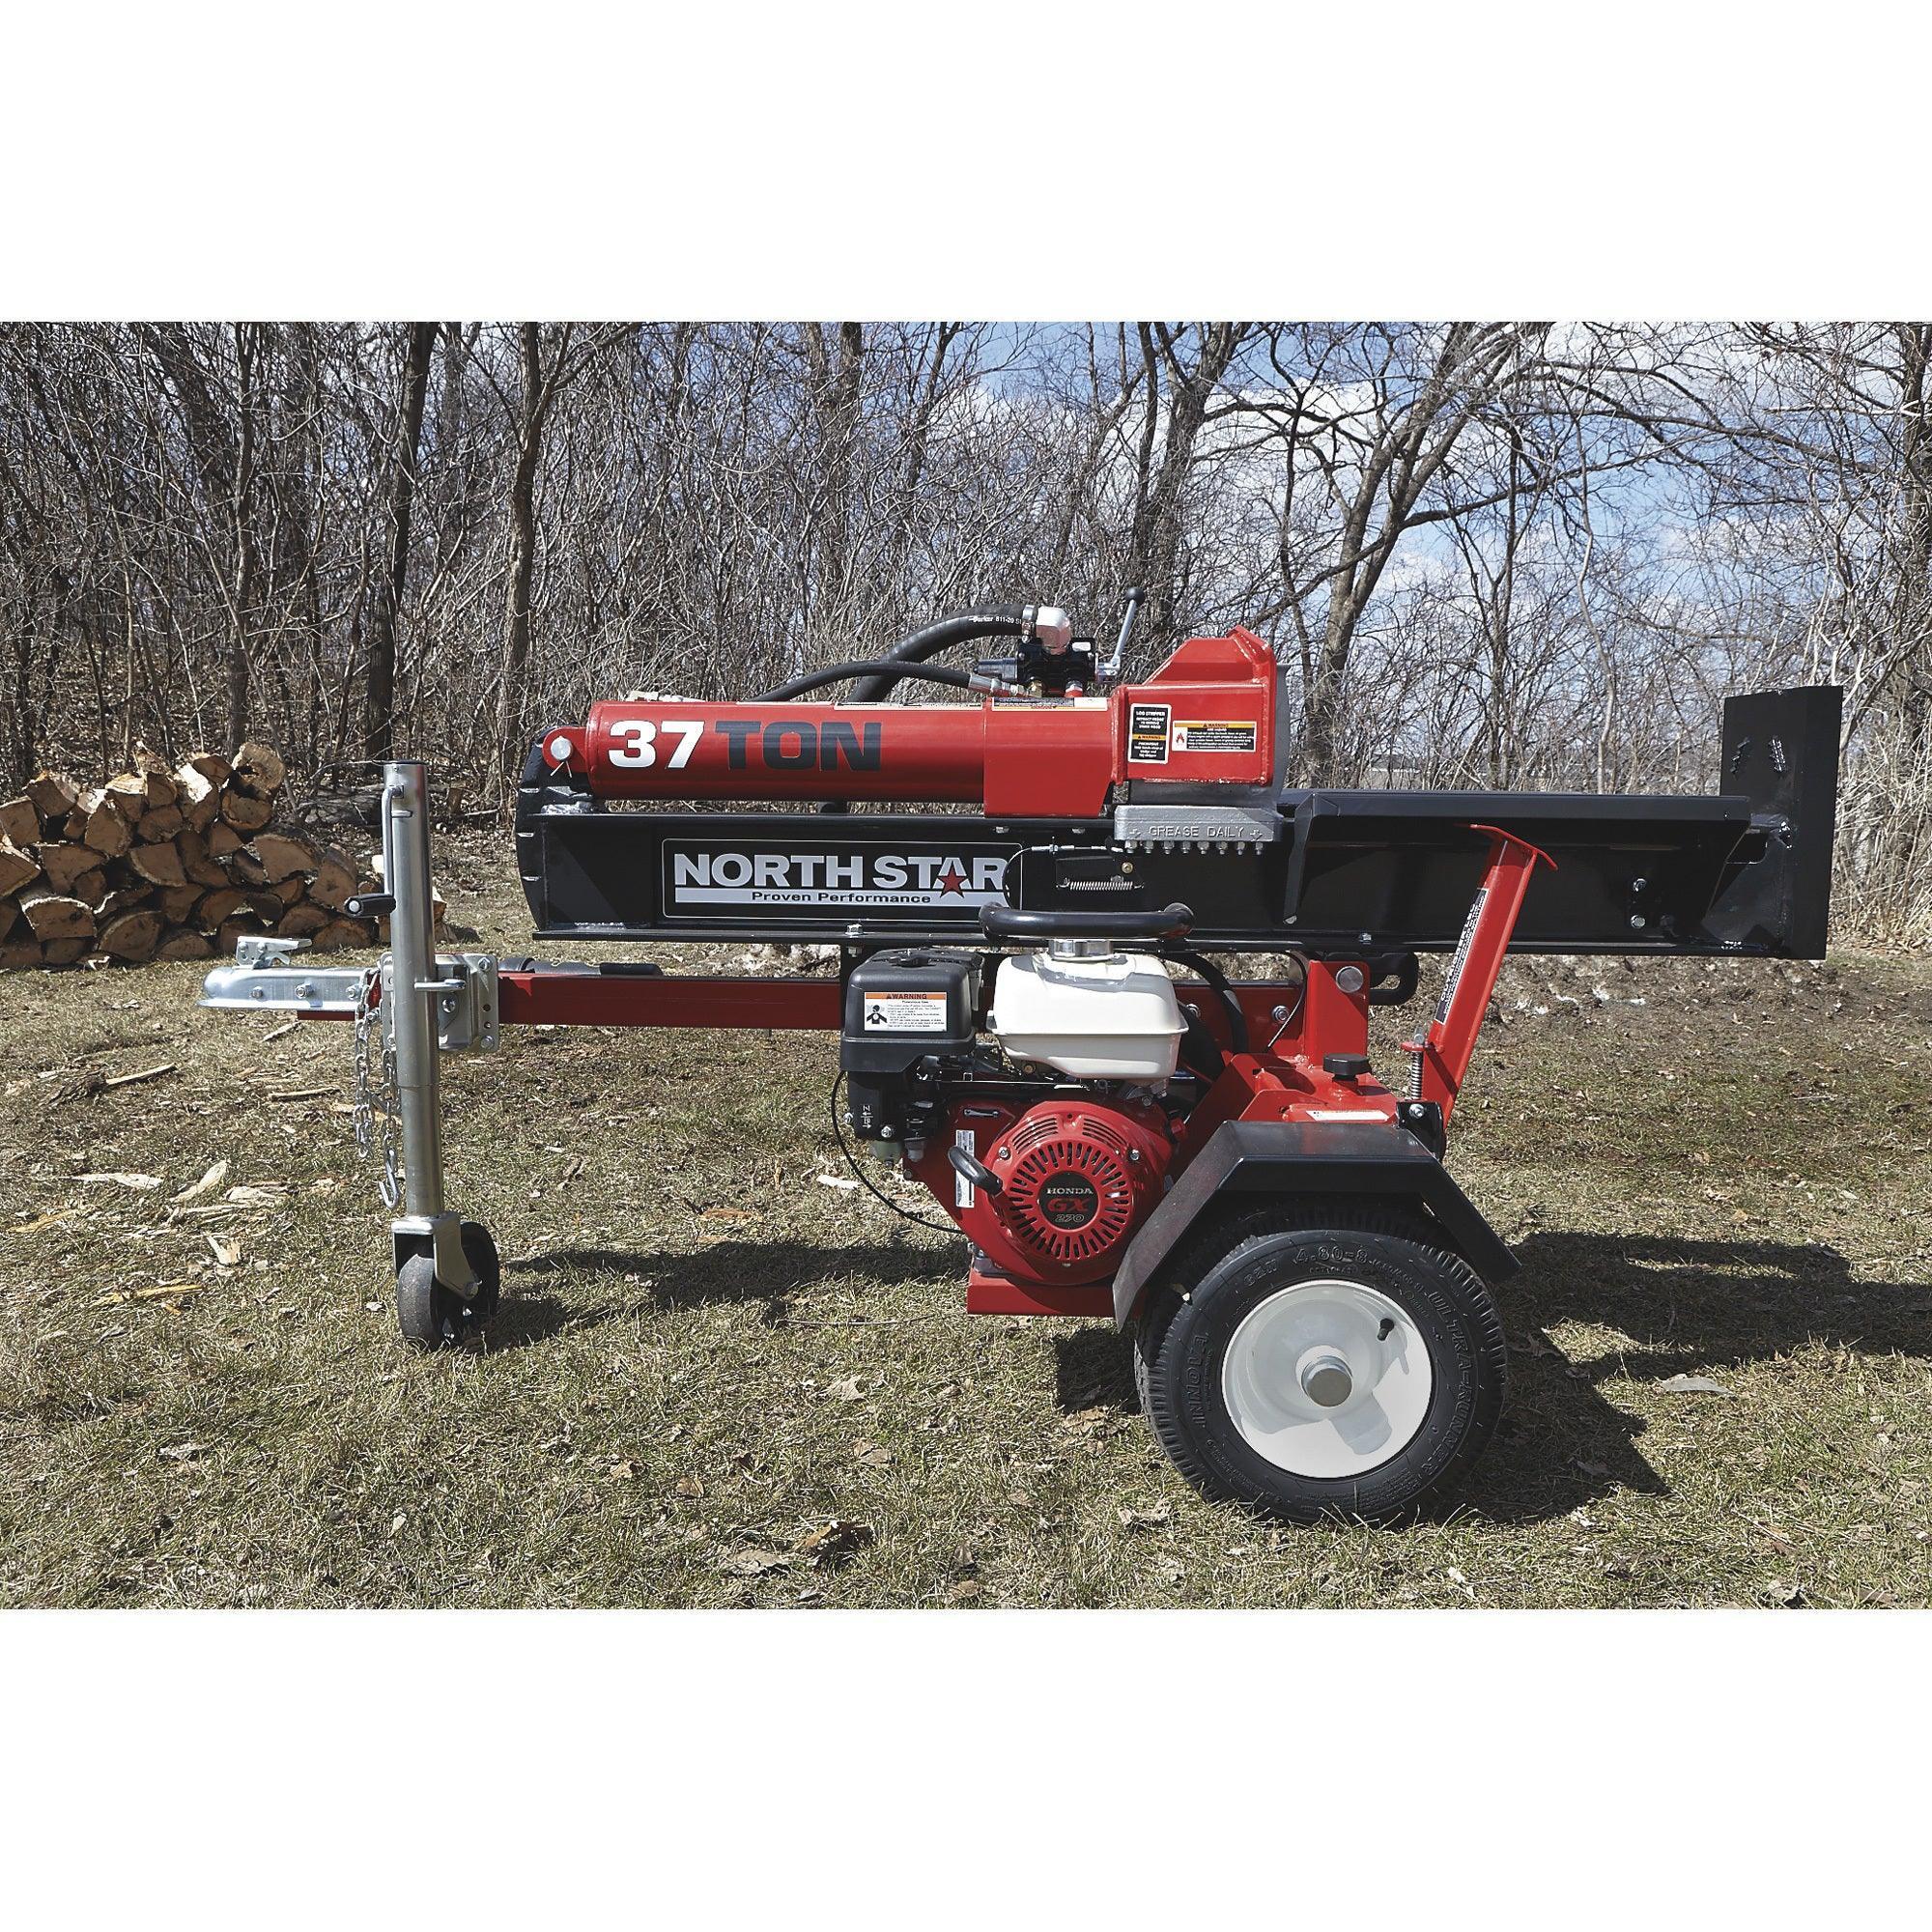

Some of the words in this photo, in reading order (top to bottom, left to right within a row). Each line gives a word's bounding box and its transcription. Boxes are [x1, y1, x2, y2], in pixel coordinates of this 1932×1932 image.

[608, 720, 705, 769] 37
[715, 720, 883, 772] TON
[1150, 826, 1200, 838] GREASE
[1208, 826, 1244, 838] DAILY
[674, 853, 864, 889] NORTH
[872, 855, 1009, 890] STAR
[752, 891, 811, 901] Proven
[817, 892, 931, 903] Performance
[1047, 1198, 1091, 1212] GX
[1054, 1213, 1085, 1223] 270
